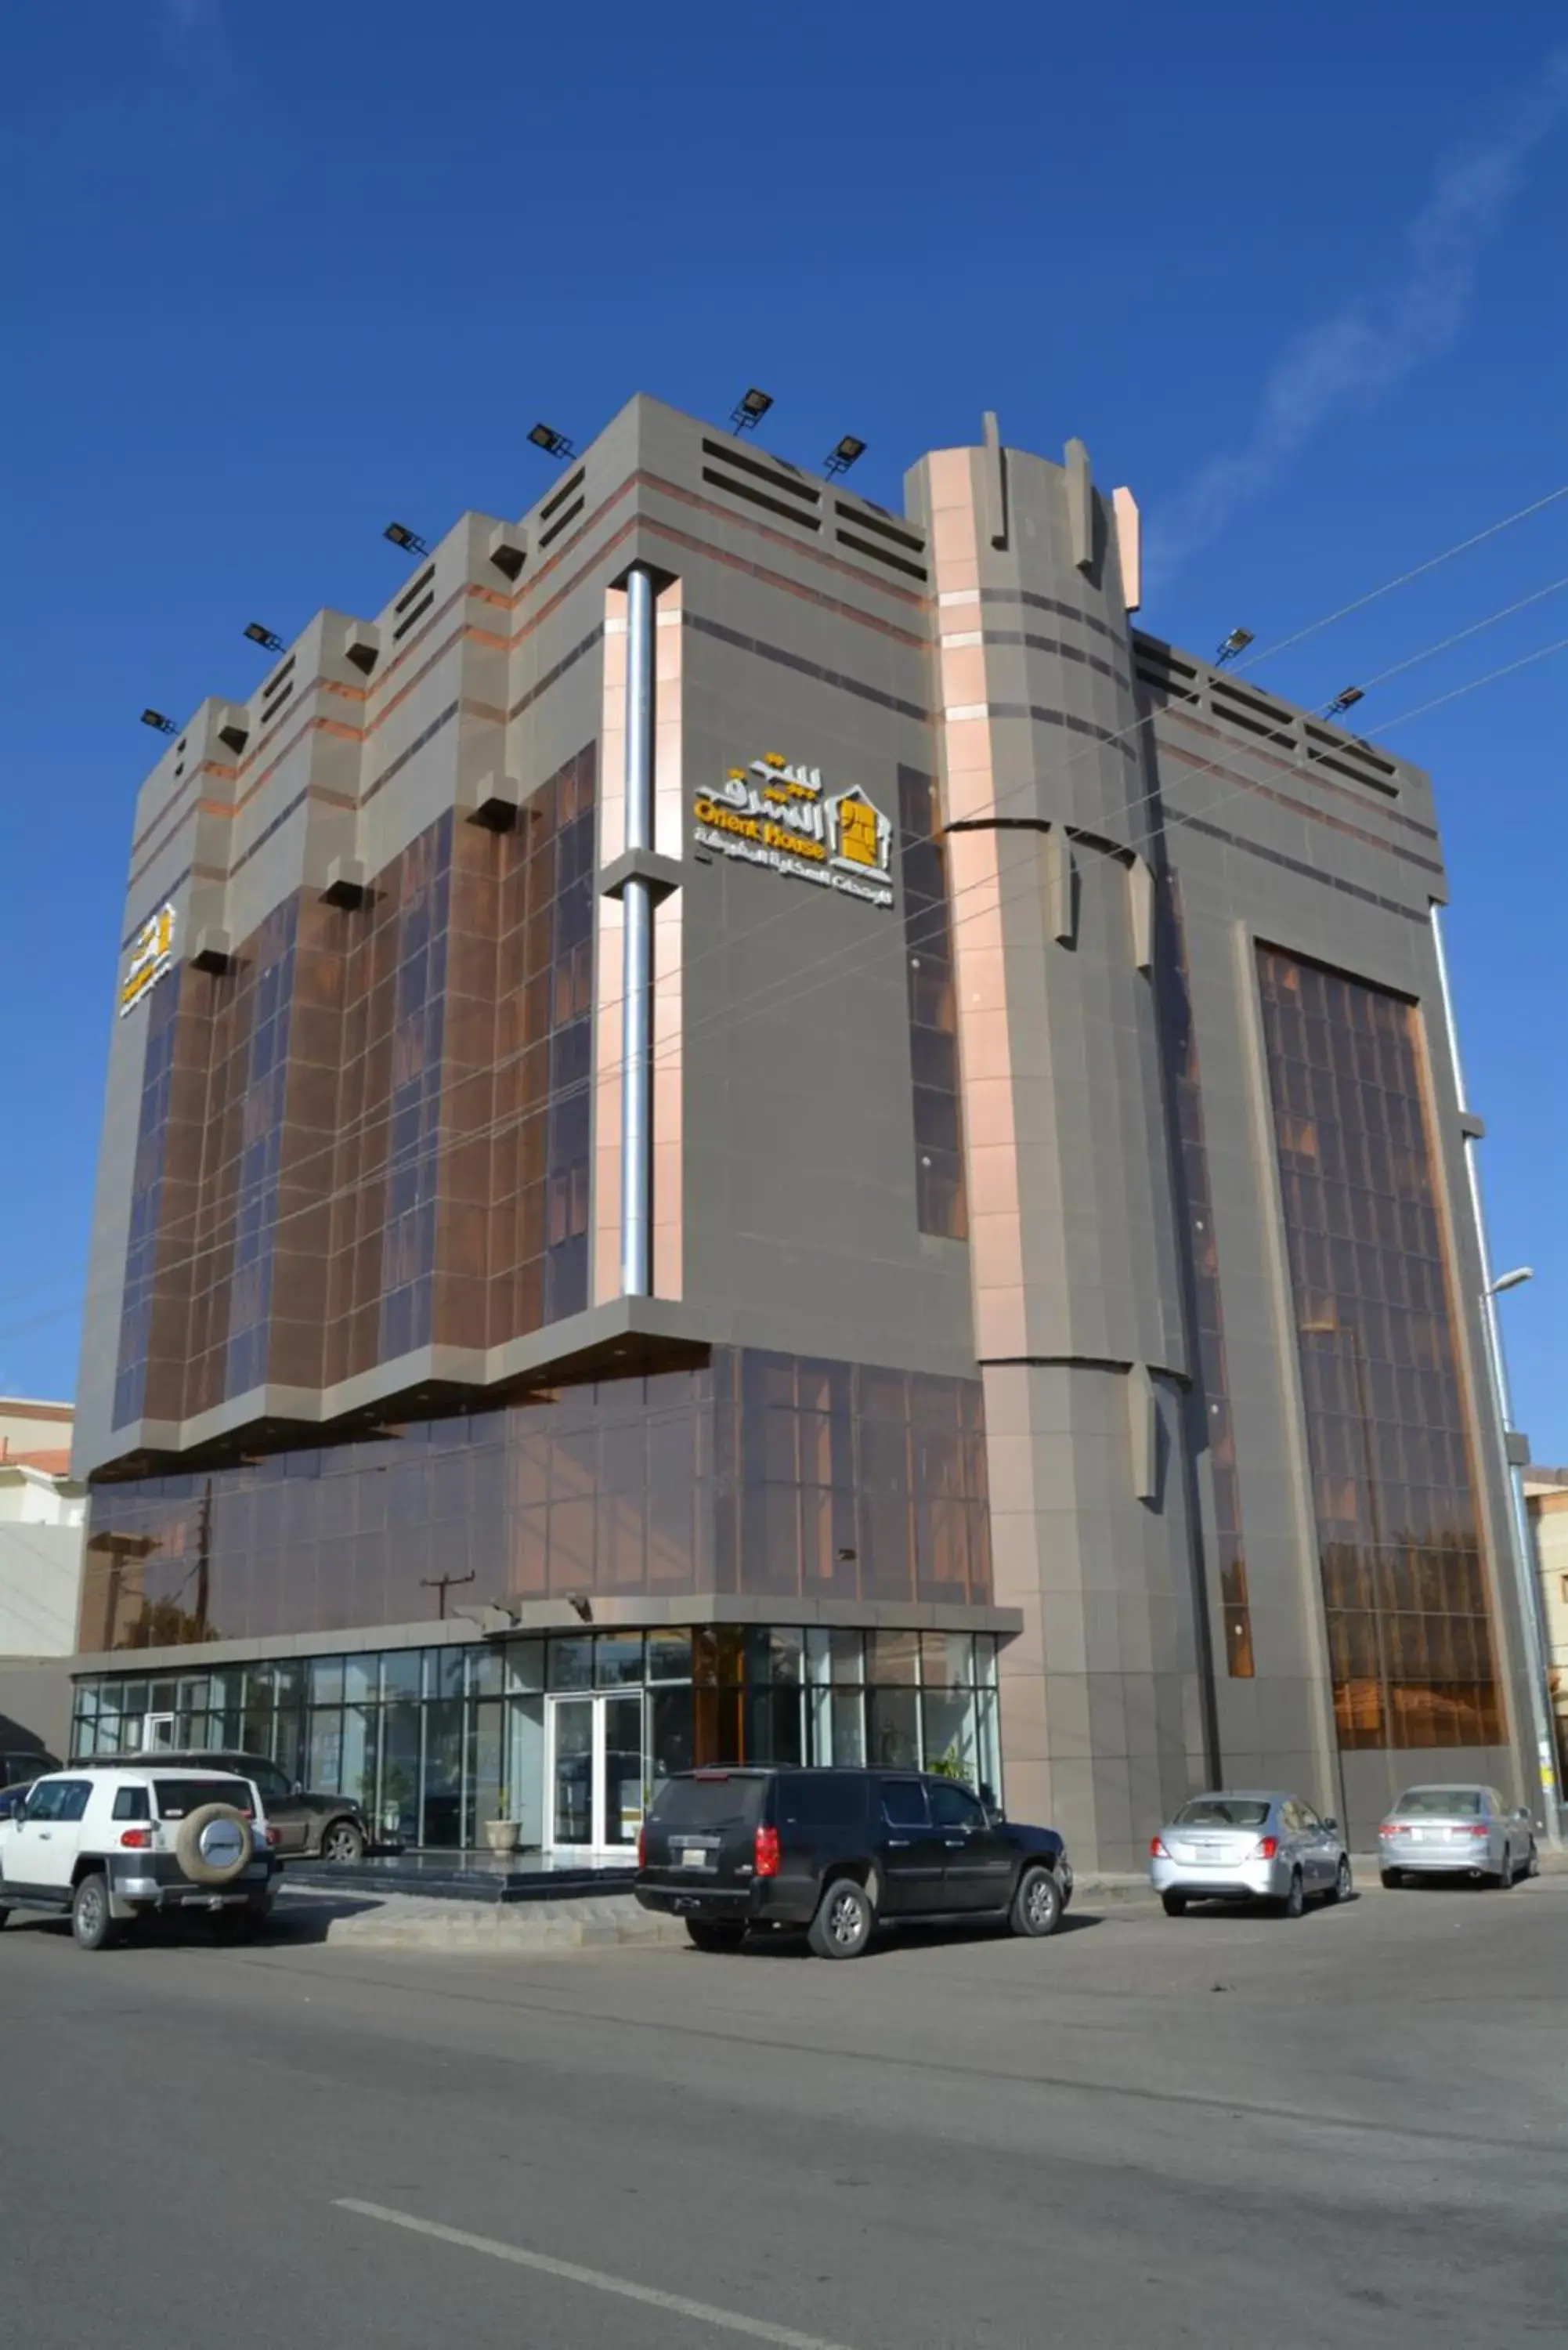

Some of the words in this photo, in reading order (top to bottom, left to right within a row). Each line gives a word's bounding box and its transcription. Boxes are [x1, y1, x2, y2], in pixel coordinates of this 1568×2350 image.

[694, 768, 822, 841] الشرق
[694, 800, 760, 841] Orient
[762, 822, 827, 862] House
